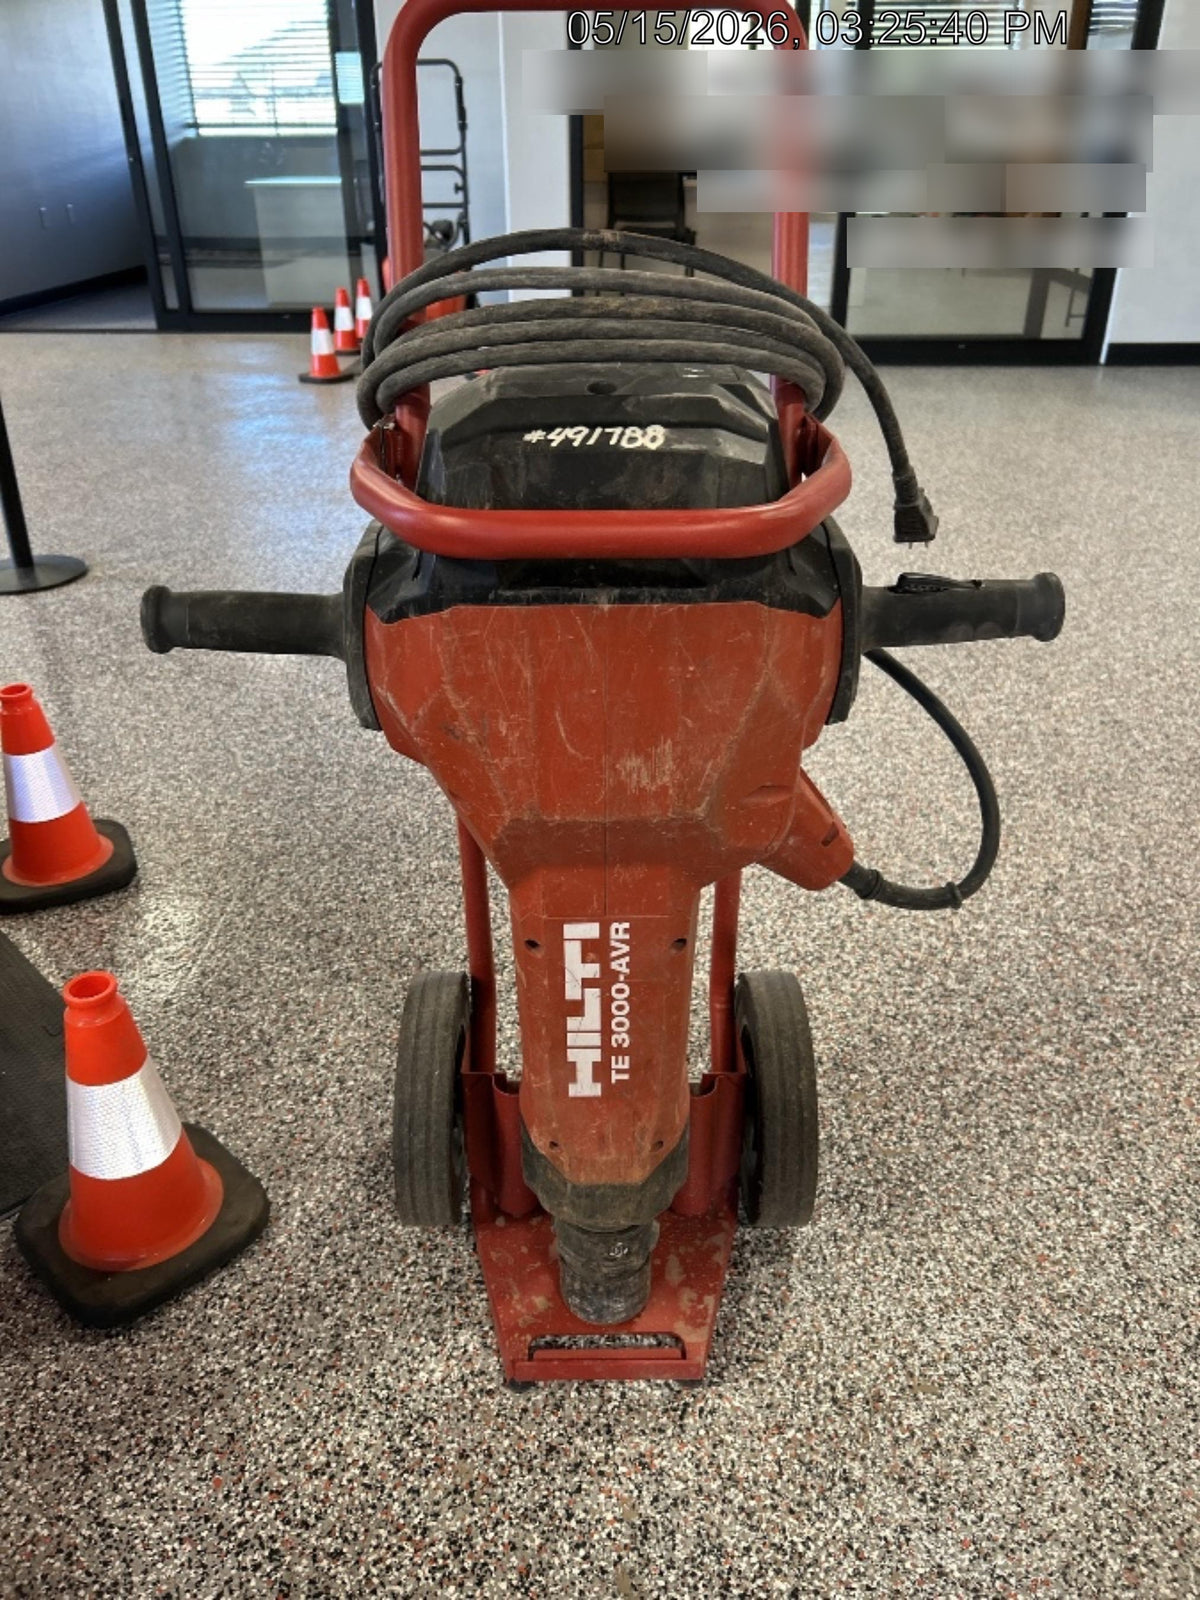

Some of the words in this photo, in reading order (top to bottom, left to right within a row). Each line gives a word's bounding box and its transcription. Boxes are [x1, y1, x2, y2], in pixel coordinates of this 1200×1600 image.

[522, 424, 666, 450] #491788
[563, 922, 601, 1098] HILTI
[609, 921, 631, 1048] 3000-AVR
[610, 1055, 631, 1084] TE
